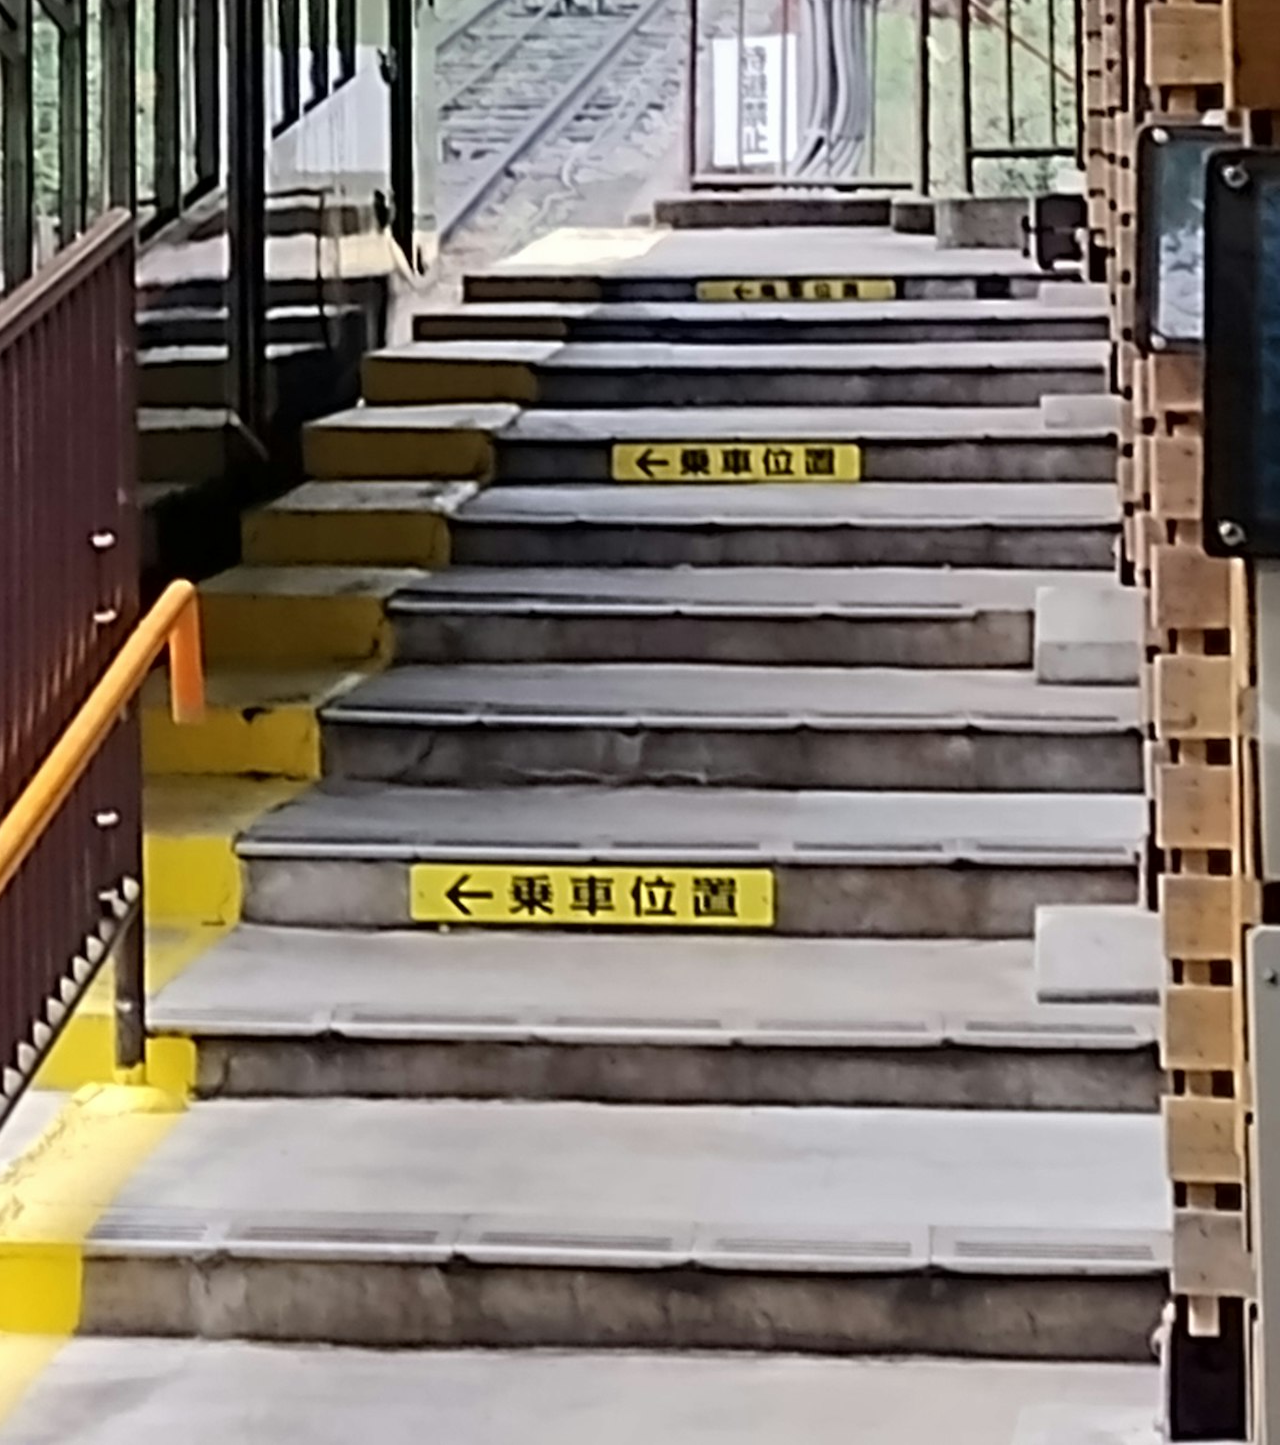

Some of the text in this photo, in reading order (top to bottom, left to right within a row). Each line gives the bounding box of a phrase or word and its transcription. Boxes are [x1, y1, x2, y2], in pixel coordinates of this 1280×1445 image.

[680, 446, 836, 476] 乗車位置
[509, 873, 739, 918] 乗車位置
